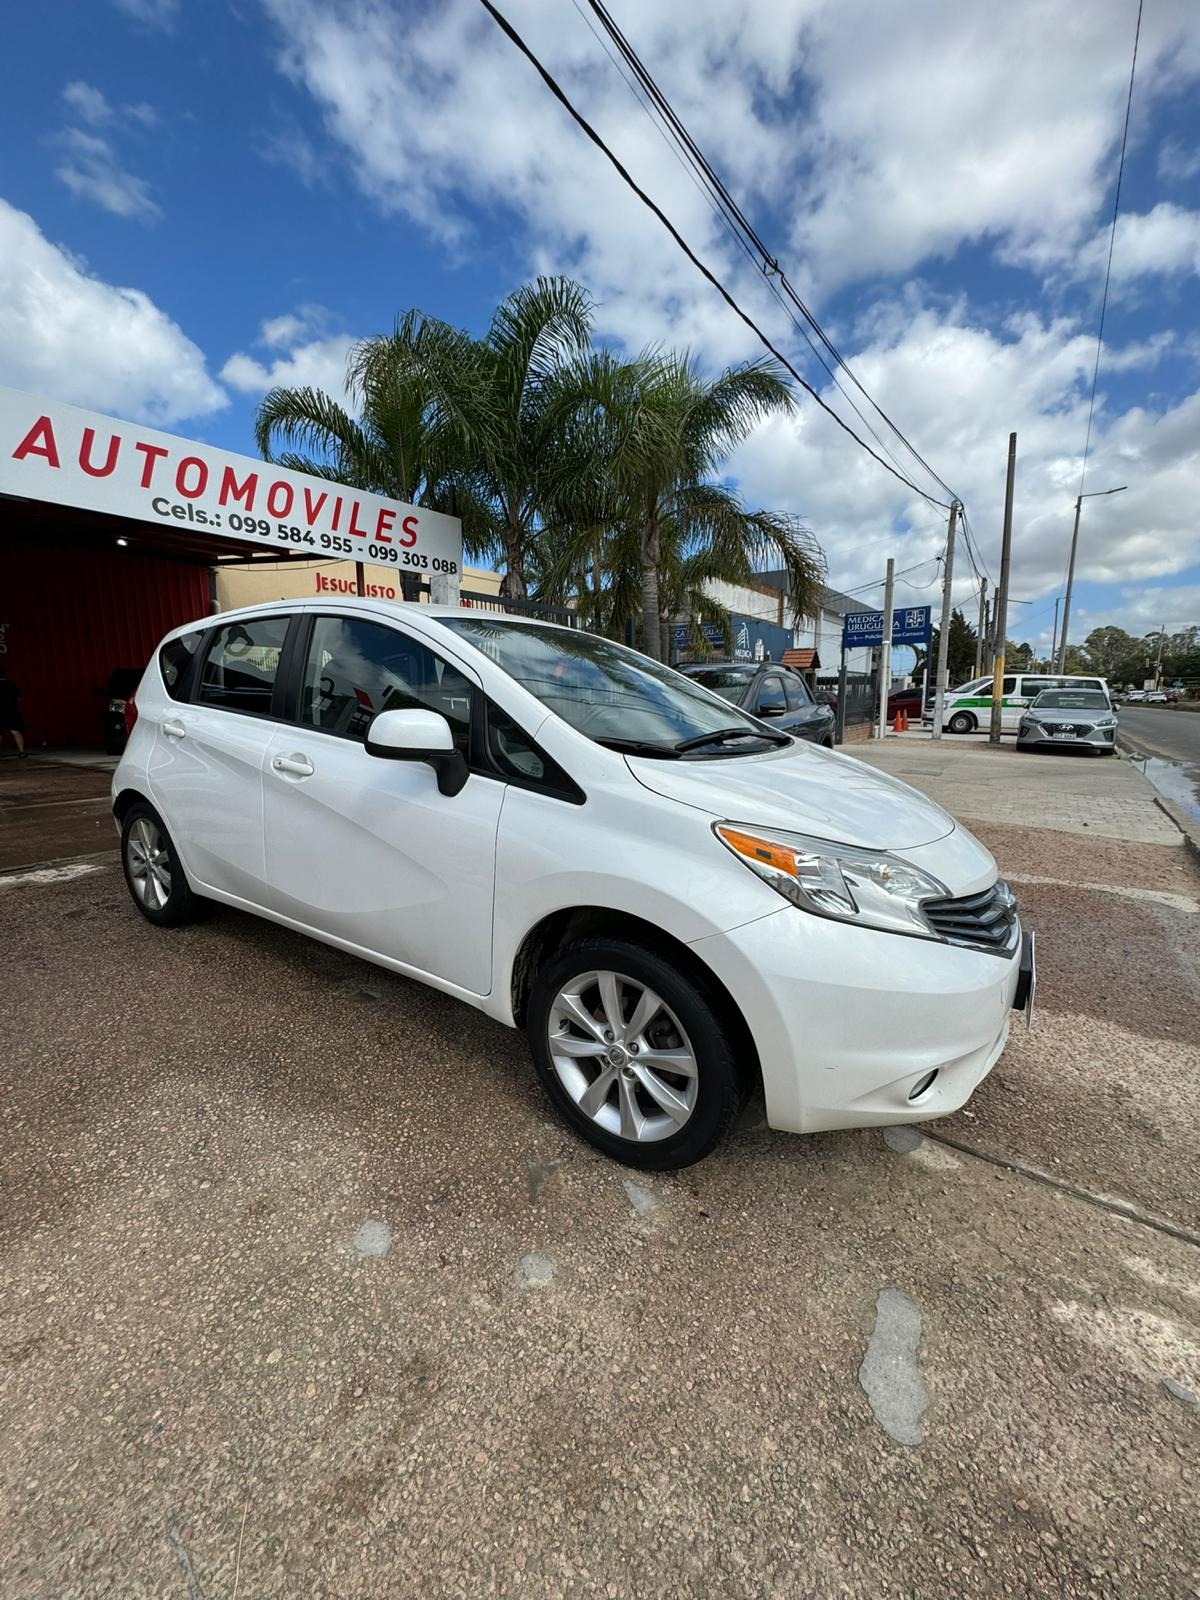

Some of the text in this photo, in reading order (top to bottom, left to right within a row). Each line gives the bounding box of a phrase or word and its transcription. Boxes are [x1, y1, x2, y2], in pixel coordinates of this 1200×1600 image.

[12, 416, 420, 548] AUTOMOVILES
[151, 497, 222, 528] Cels.:
[228, 513, 271, 537] 099
[277, 523, 316, 546] 584
[320, 533, 353, 554] 955
[368, 544, 398, 562] 099
[402, 550, 429, 569] 303
[432, 557, 458, 574] 088
[315, 572, 395, 600] JESUCISTO
[848, 620, 900, 631] URUGUA
